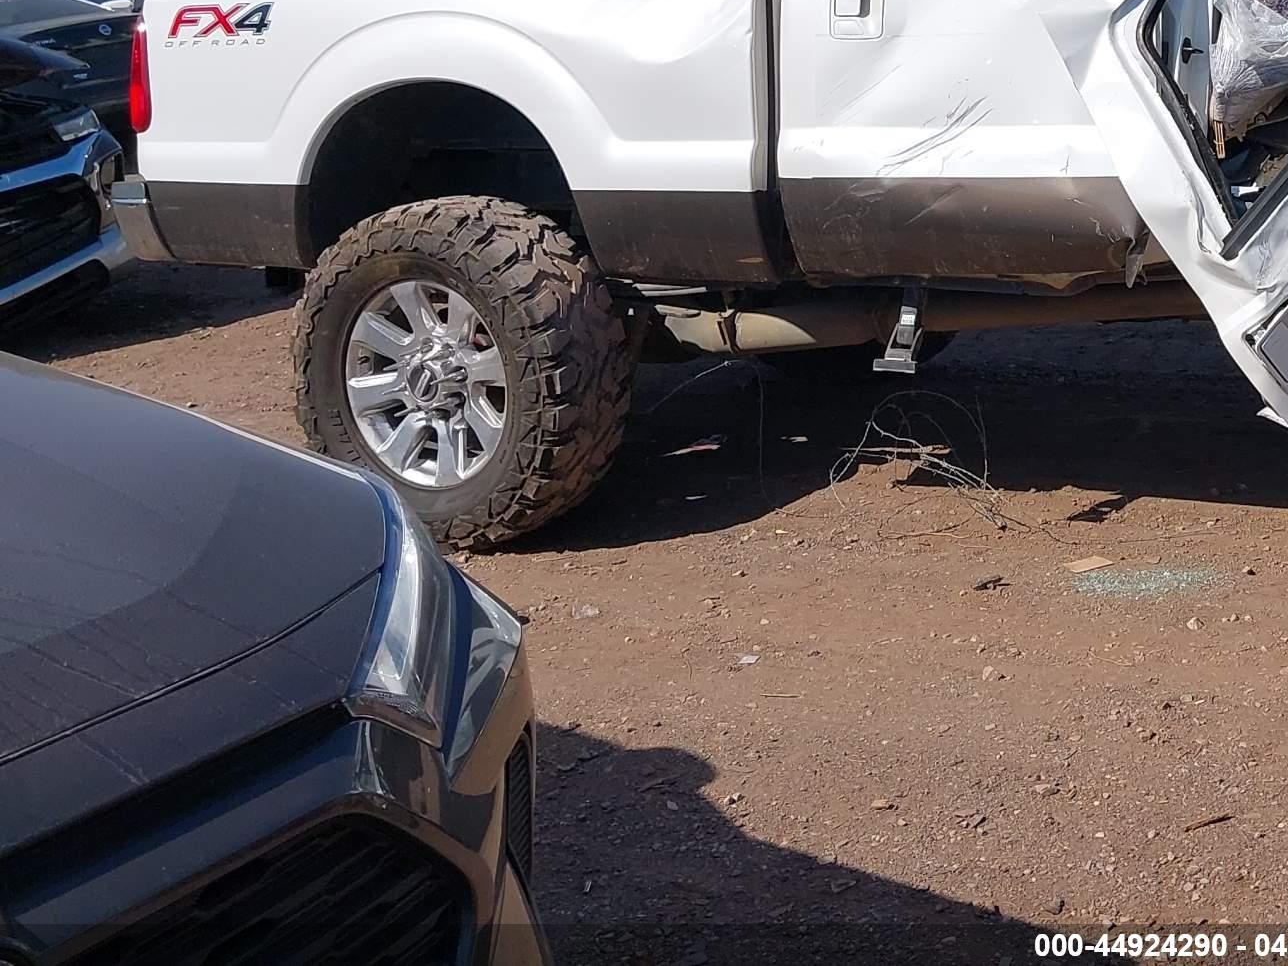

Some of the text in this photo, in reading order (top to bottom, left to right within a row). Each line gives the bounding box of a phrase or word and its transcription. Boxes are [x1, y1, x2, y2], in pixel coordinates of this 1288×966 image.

[168, 2, 274, 38] FX4
[164, 38, 266, 48] OFF ROAD
